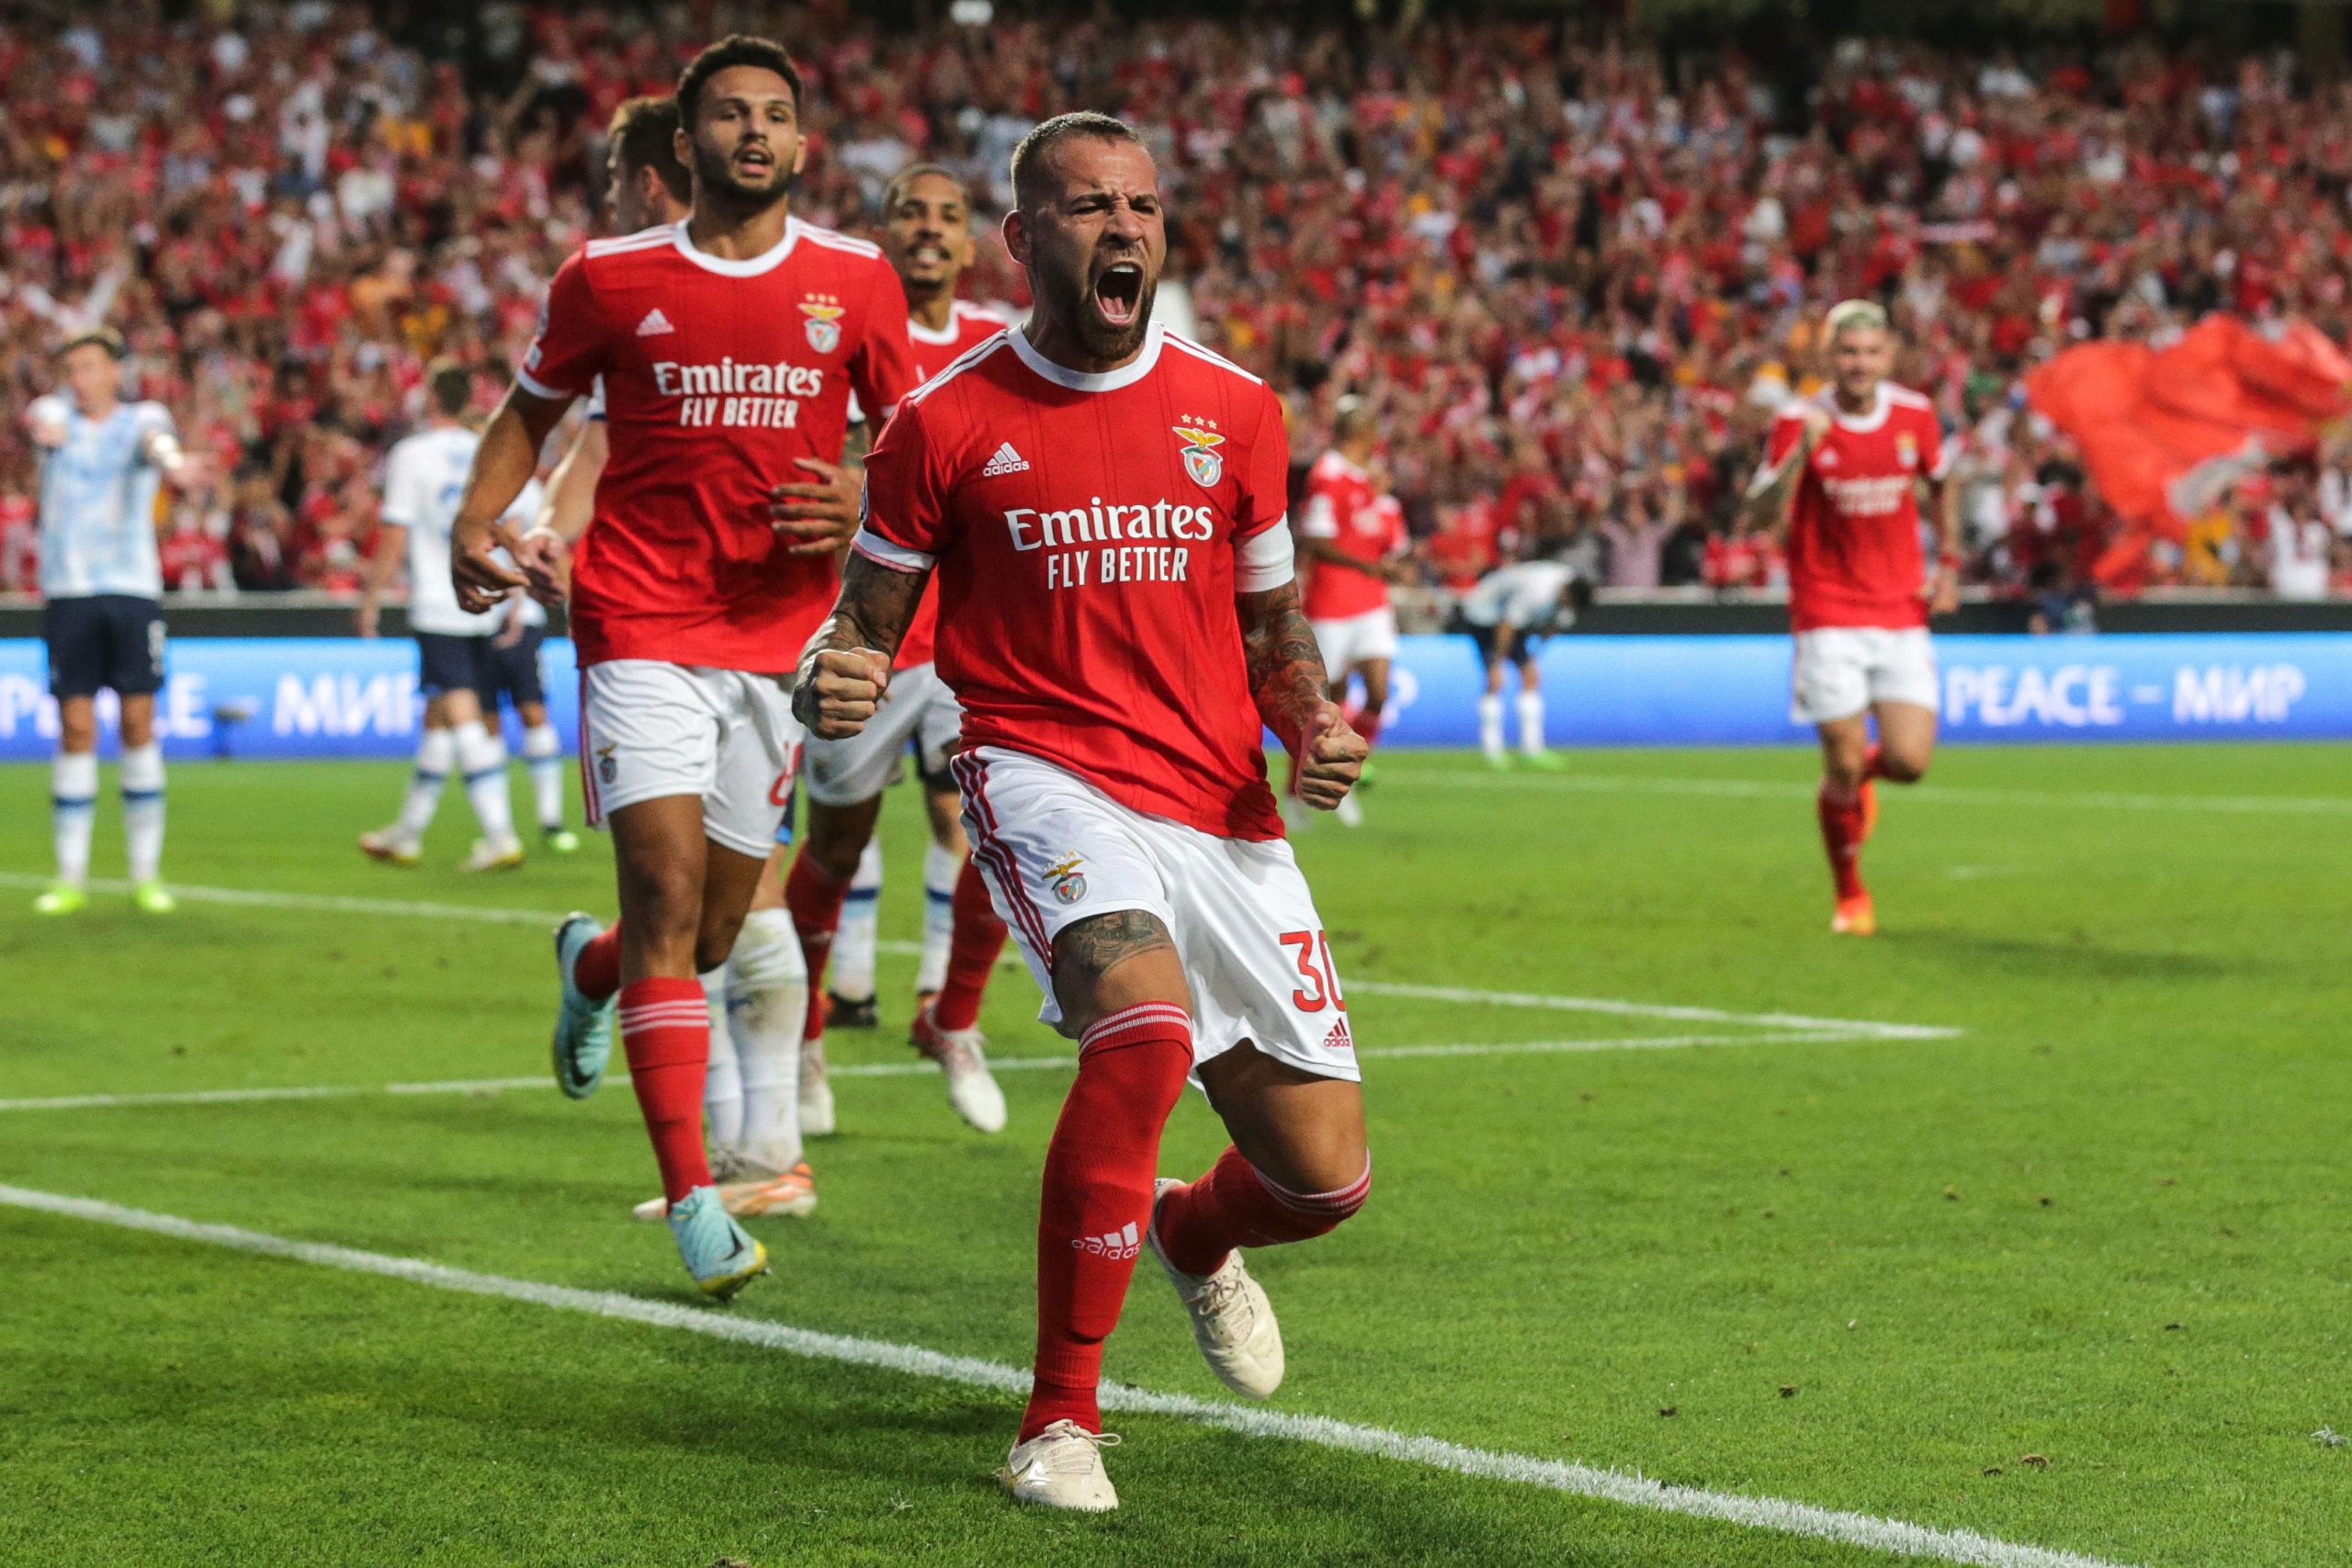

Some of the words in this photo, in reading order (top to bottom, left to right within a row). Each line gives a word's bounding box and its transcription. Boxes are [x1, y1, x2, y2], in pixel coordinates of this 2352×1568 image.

[652, 355, 824, 397] Emirates
[679, 397, 718, 426] FLY
[722, 397, 799, 428] BETTER
[982, 460, 1030, 477] adidas
[1003, 496, 1214, 551] Emirates
[1047, 550, 1090, 590] FLY
[1101, 547, 1189, 583] BETTER
[1945, 664, 2123, 727] PEACE
[1071, 1237, 1141, 1260] adidas
